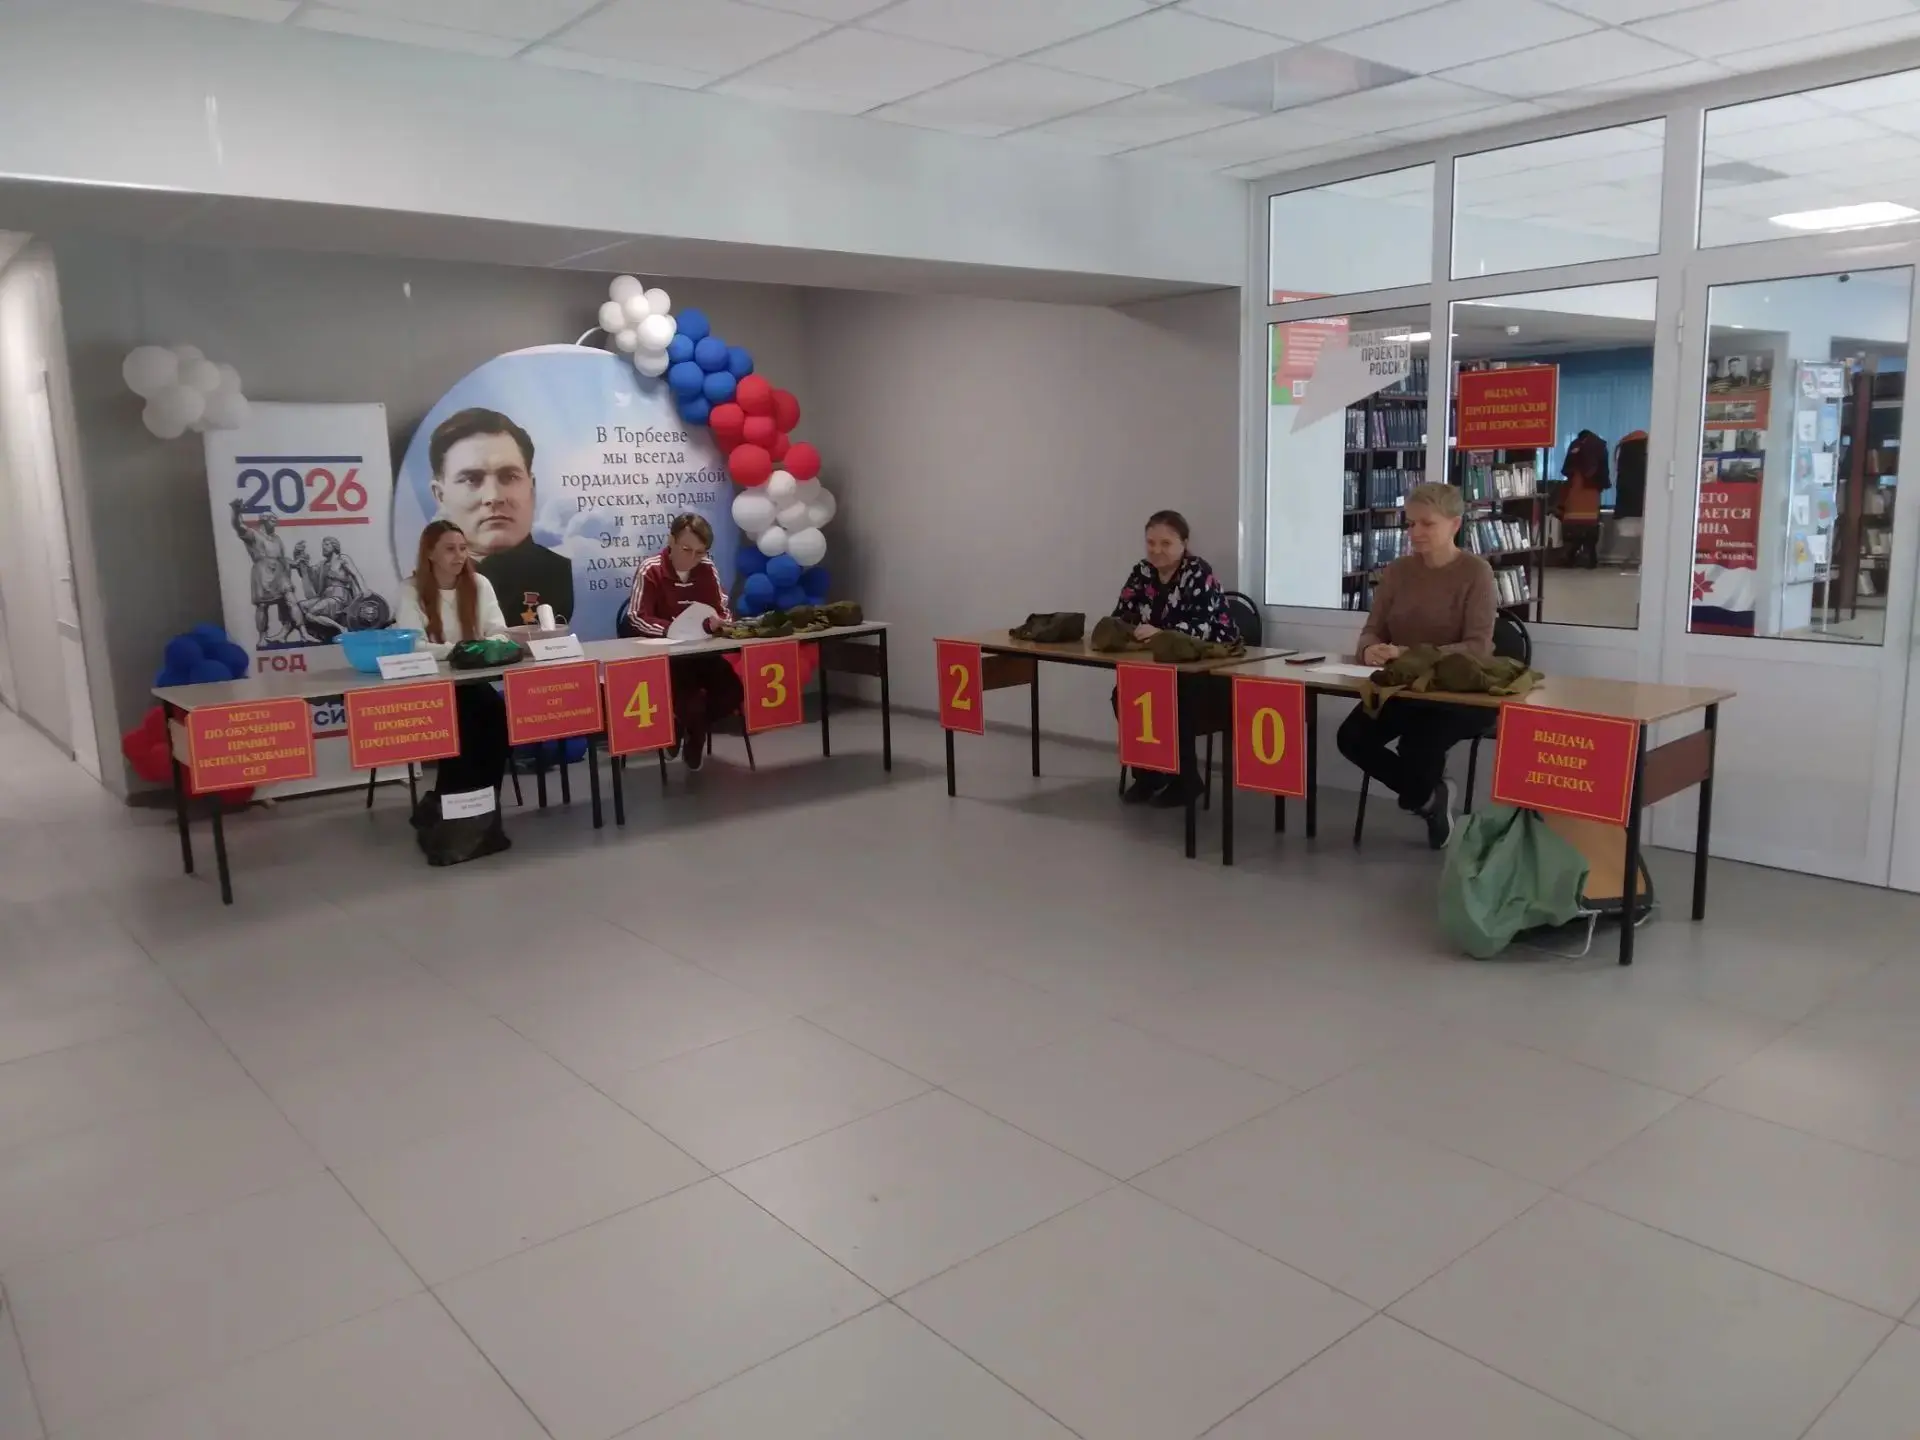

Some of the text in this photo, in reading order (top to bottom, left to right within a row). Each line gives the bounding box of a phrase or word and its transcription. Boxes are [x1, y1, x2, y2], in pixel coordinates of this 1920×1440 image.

[1361, 345, 1408, 362] ПРОЕКТЫ
[1369, 360, 1408, 375] РОССИИ
[1484, 387, 1528, 399] ВЫДАЧА
[596, 426, 688, 447] В Торбееве
[603, 452, 685, 464] мы всегда
[562, 467, 726, 491] гордились дружбой
[237, 468, 368, 514] 2026
[1700, 492, 1729, 504] ЕГО
[577, 491, 715, 512] русских, мордвы
[614, 515, 624, 526] и
[1701, 507, 1752, 519] АЕТСЯ
[599, 531, 667, 550] Эта дру
[587, 555, 646, 572] должн
[589, 577, 632, 591] во вс
[257, 654, 307, 674] ГОД
[760, 663, 787, 708] 3
[949, 664, 971, 711] 2
[360, 699, 444, 716] ТЕХНИЧЕСКАЯ
[623, 681, 658, 728] 4
[228, 710, 270, 721] МЕСТО
[314, 708, 346, 726] СИ
[374, 716, 434, 731] ПРОВЕРКА
[1134, 691, 1161, 744] 1
[204, 721, 295, 739] ПО ОБУЧЕНИЮ
[360, 729, 449, 749] ПРОТИВОГАЗОВ
[1252, 707, 1285, 765] 0
[228, 736, 276, 751] ПРАВИЛ
[1533, 730, 1595, 750] ВЫДАЧА
[199, 747, 305, 768] ИСПОЛЬЗОВАНИЯ
[1537, 751, 1588, 770] КАМЕР
[1525, 770, 1596, 793] ДЕТСКИХ
